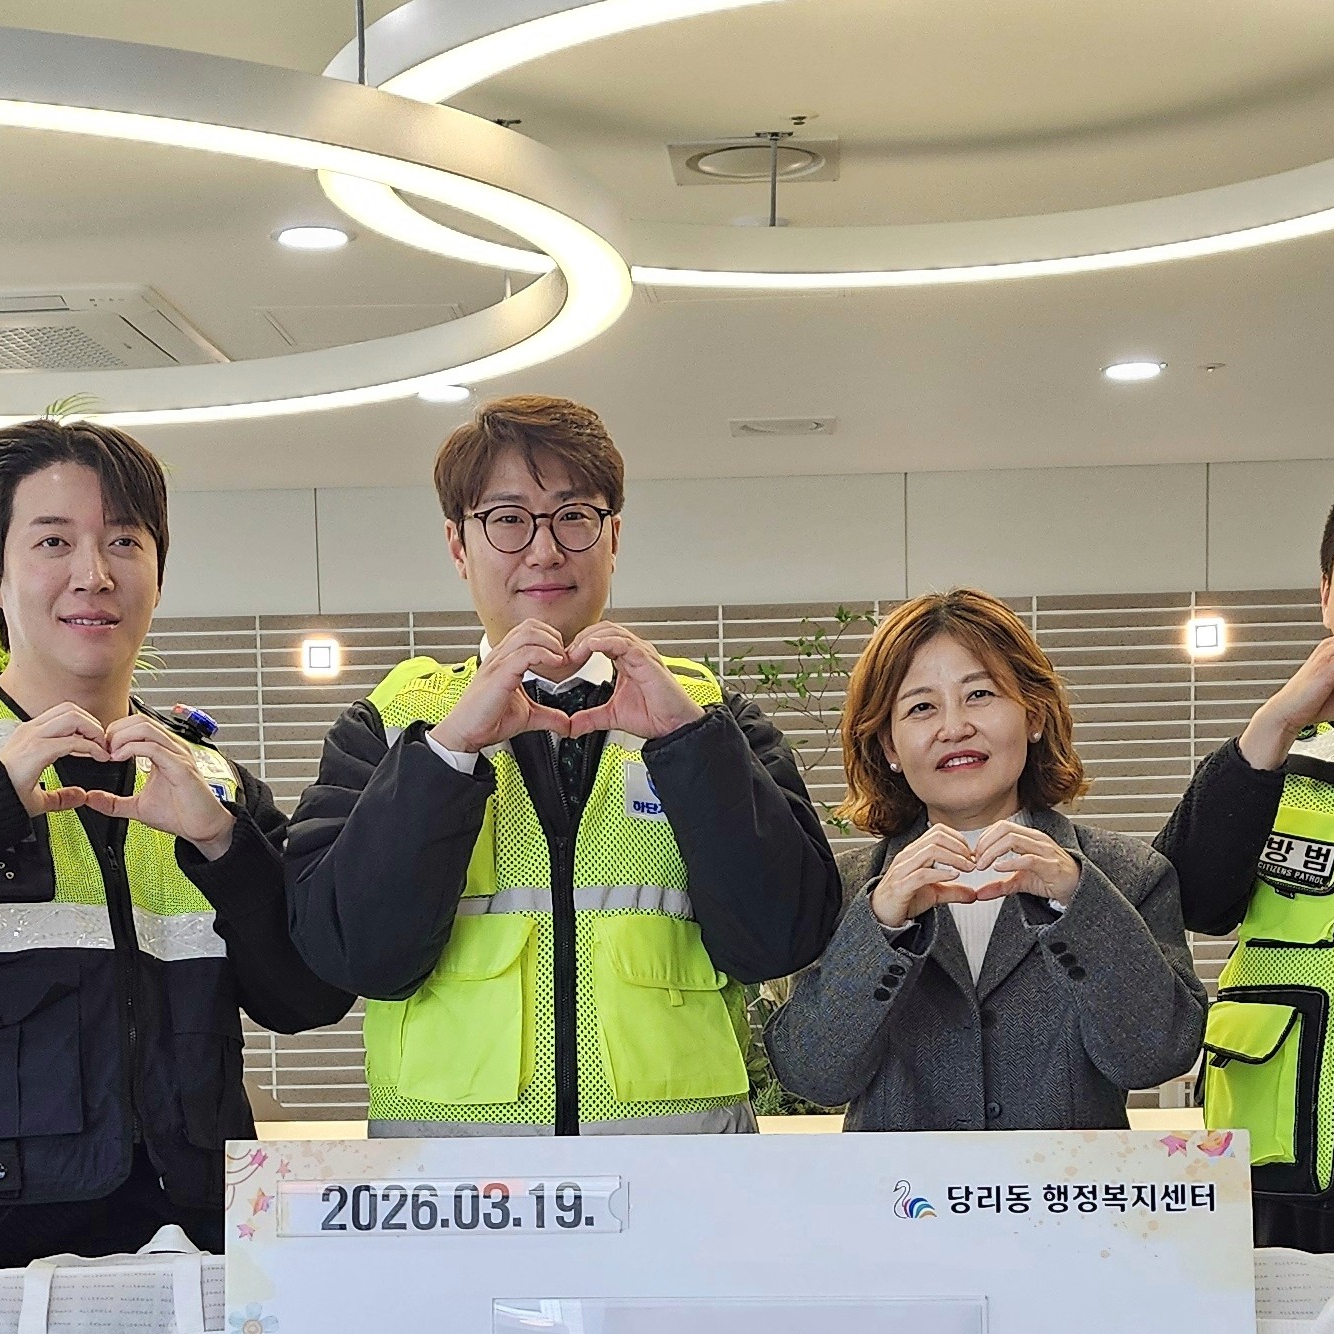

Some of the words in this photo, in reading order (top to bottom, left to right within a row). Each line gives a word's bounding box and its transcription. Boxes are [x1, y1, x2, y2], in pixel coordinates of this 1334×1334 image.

[1257, 861, 1292, 877] CITIZENS
[1294, 871, 1324, 885] PATROL
[320, 1182, 595, 1232] 2026.03.19.
[947, 1184, 1032, 1214] 당리동
[1042, 1183, 1215, 1214] 행정복지센터
